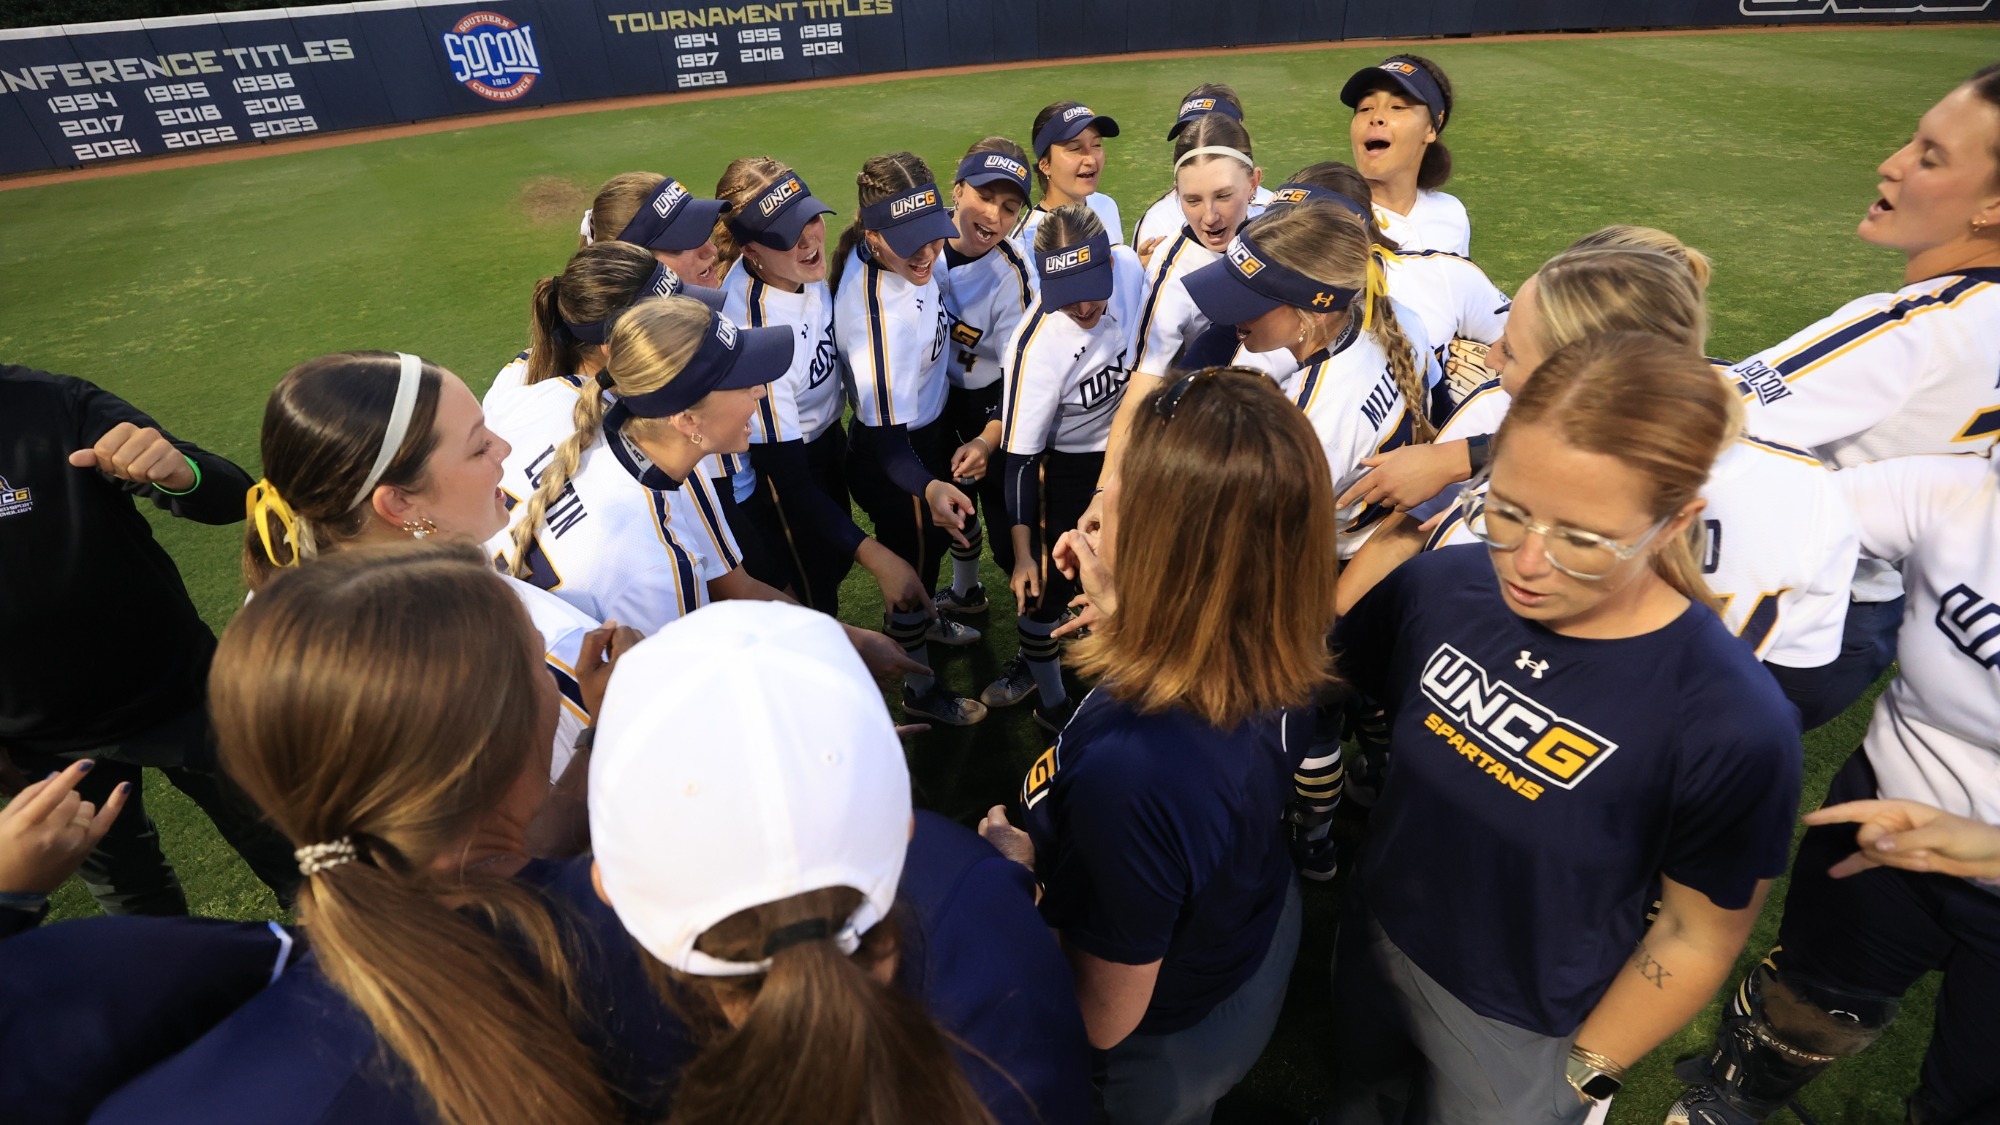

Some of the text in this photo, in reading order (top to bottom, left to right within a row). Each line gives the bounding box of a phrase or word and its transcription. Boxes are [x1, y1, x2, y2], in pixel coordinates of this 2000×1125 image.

[458, 14, 510, 32] SOUTHERN
[608, 0, 893, 33] TOURNAMENT TITLES
[674, 23, 842, 49] 1994 1995 1996
[0, 38, 354, 93] NFERENCE TITLES
[443, 25, 540, 82] SOCON
[677, 41, 843, 68] 1997 2018 2021
[47, 72, 295, 113] 1994 1995 1996
[472, 76, 532, 99] CONFERENCE
[492, 77, 511, 86] 1921
[677, 70, 728, 87] 2023
[58, 94, 305, 137] 2017 2018 2019
[71, 115, 318, 160] 2021 2022 2023
[984, 155, 1028, 180] UNCG
[759, 178, 802, 217] UNCG
[891, 189, 937, 219] UNCG
[1045, 245, 1090, 273] UNCG
[958, 350, 979, 373] 4
[1733, 360, 1793, 406] SOCON
[1420, 642, 1619, 790] UNCG
[1424, 712, 1546, 801] SPARTANS
